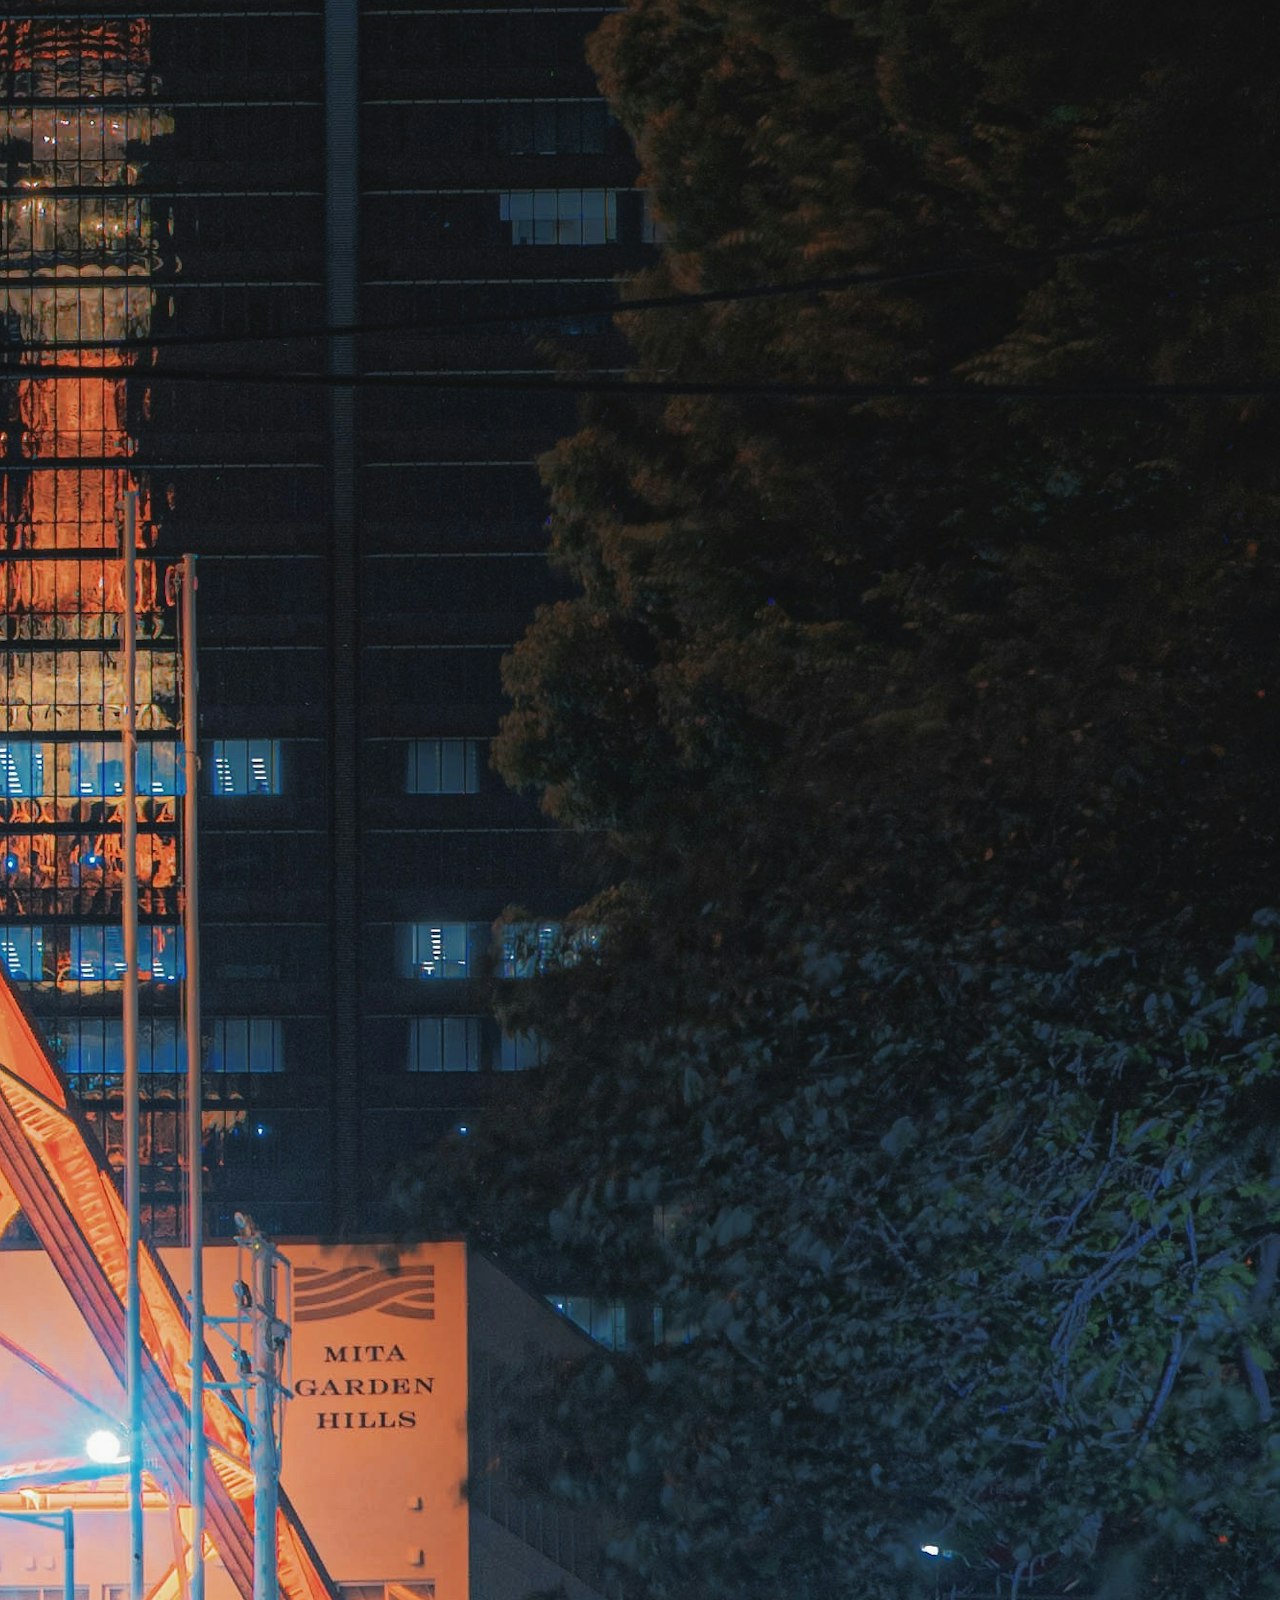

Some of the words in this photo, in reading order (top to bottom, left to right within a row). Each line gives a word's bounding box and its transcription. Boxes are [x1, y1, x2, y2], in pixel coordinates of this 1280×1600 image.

[324, 1344, 406, 1363] MITA
[294, 1377, 435, 1397] GARDEN
[317, 1411, 417, 1429] HILLS
